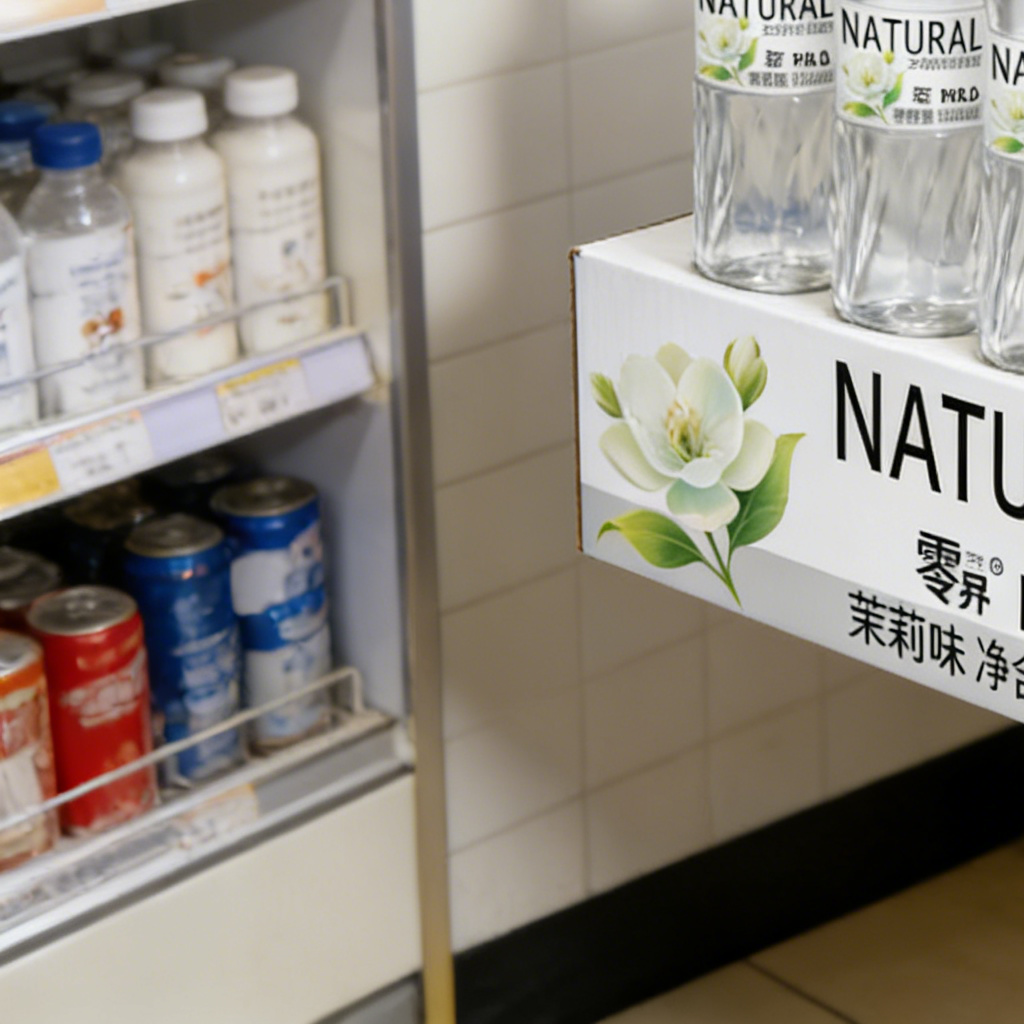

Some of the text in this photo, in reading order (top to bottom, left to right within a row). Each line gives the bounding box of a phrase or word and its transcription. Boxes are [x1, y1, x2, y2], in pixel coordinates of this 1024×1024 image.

[841, 8, 984, 55] NATURAL
[847, 589, 966, 678] 茉莉味
